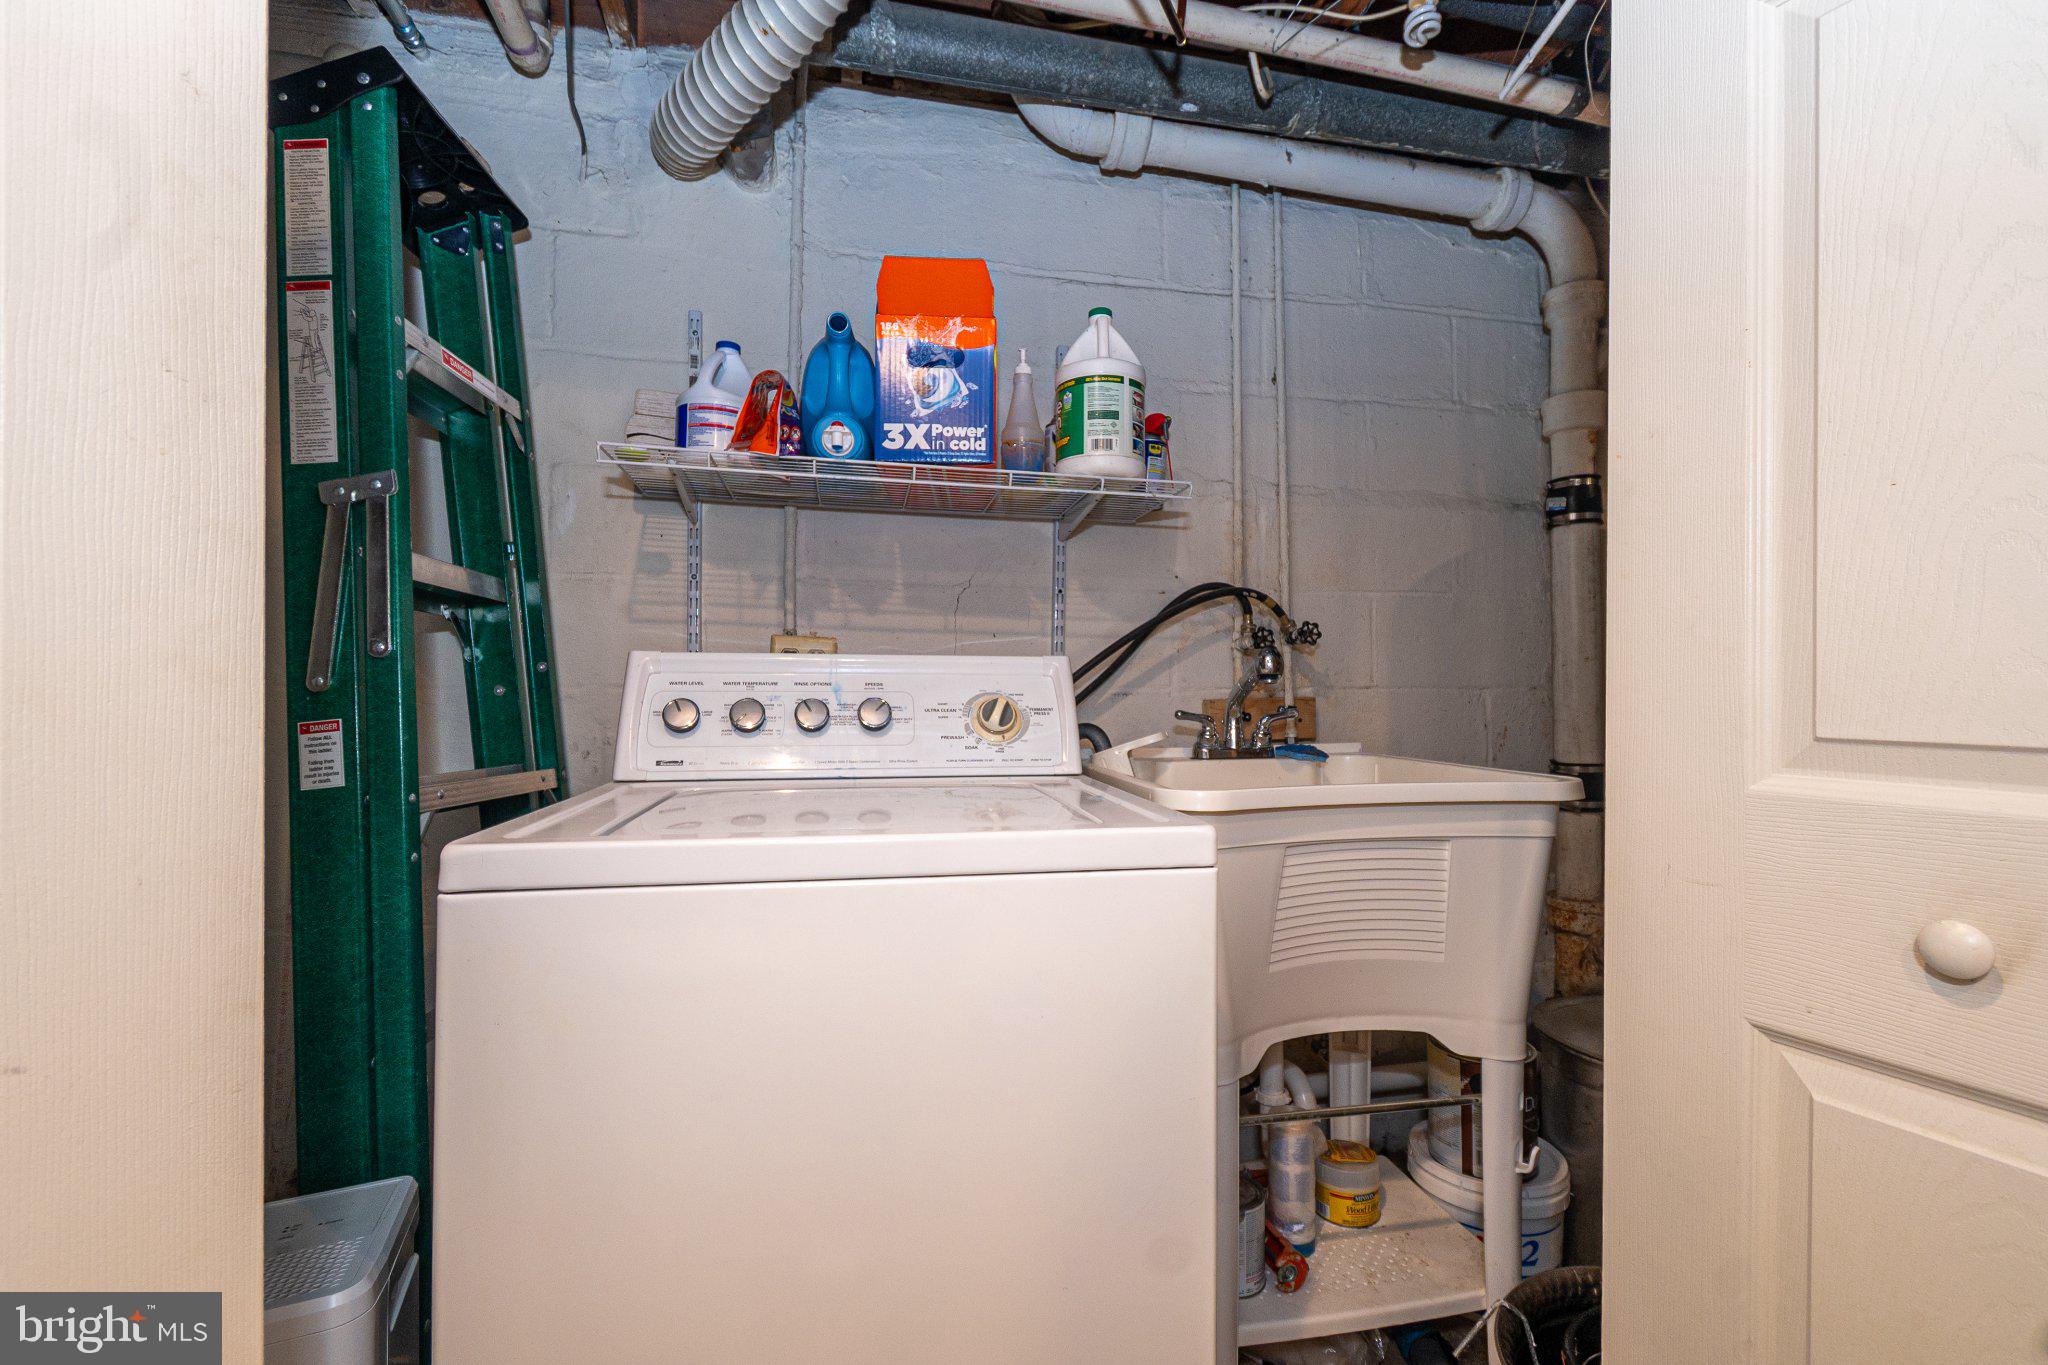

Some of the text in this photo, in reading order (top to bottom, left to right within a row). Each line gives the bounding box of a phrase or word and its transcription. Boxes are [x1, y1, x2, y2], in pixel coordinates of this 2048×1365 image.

[882, 423, 930, 449] 3X
[932, 437, 986, 451] in cold
[309, 723, 337, 732] DANGER
[1522, 1240, 1539, 1266] 2
